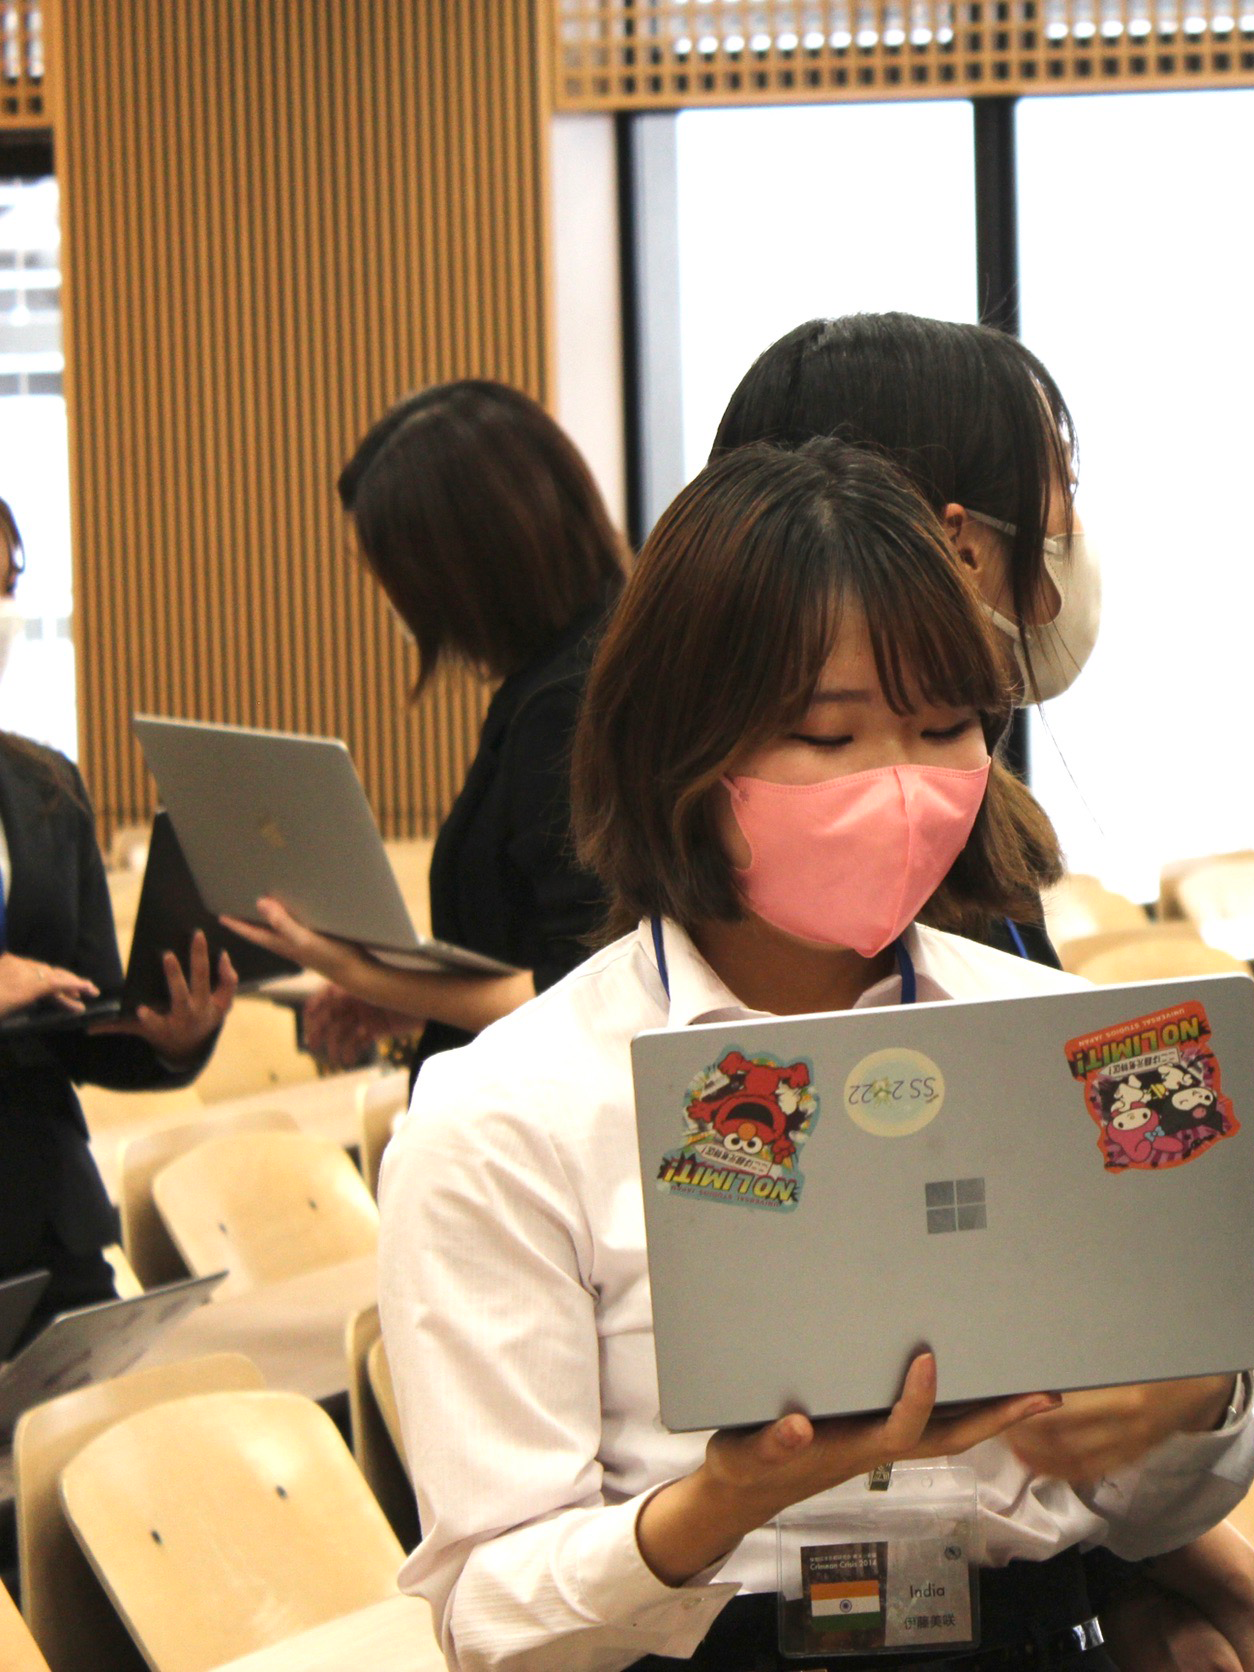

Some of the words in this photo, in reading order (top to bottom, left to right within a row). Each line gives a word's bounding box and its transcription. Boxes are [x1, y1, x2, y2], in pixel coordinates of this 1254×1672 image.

[1142, 1008, 1185, 1026] UNIVERSAL
[1078, 1034, 1103, 1047] JAPAN
[1105, 1024, 1140, 1038] STUDIOS
[1161, 1016, 1199, 1045] NO
[1076, 1030, 1159, 1074] LIMIT!
[910, 1077, 936, 1099] SS
[662, 1158, 754, 1194] LIMIT!
[753, 1174, 797, 1201] NO
[909, 1583, 945, 1599] India
